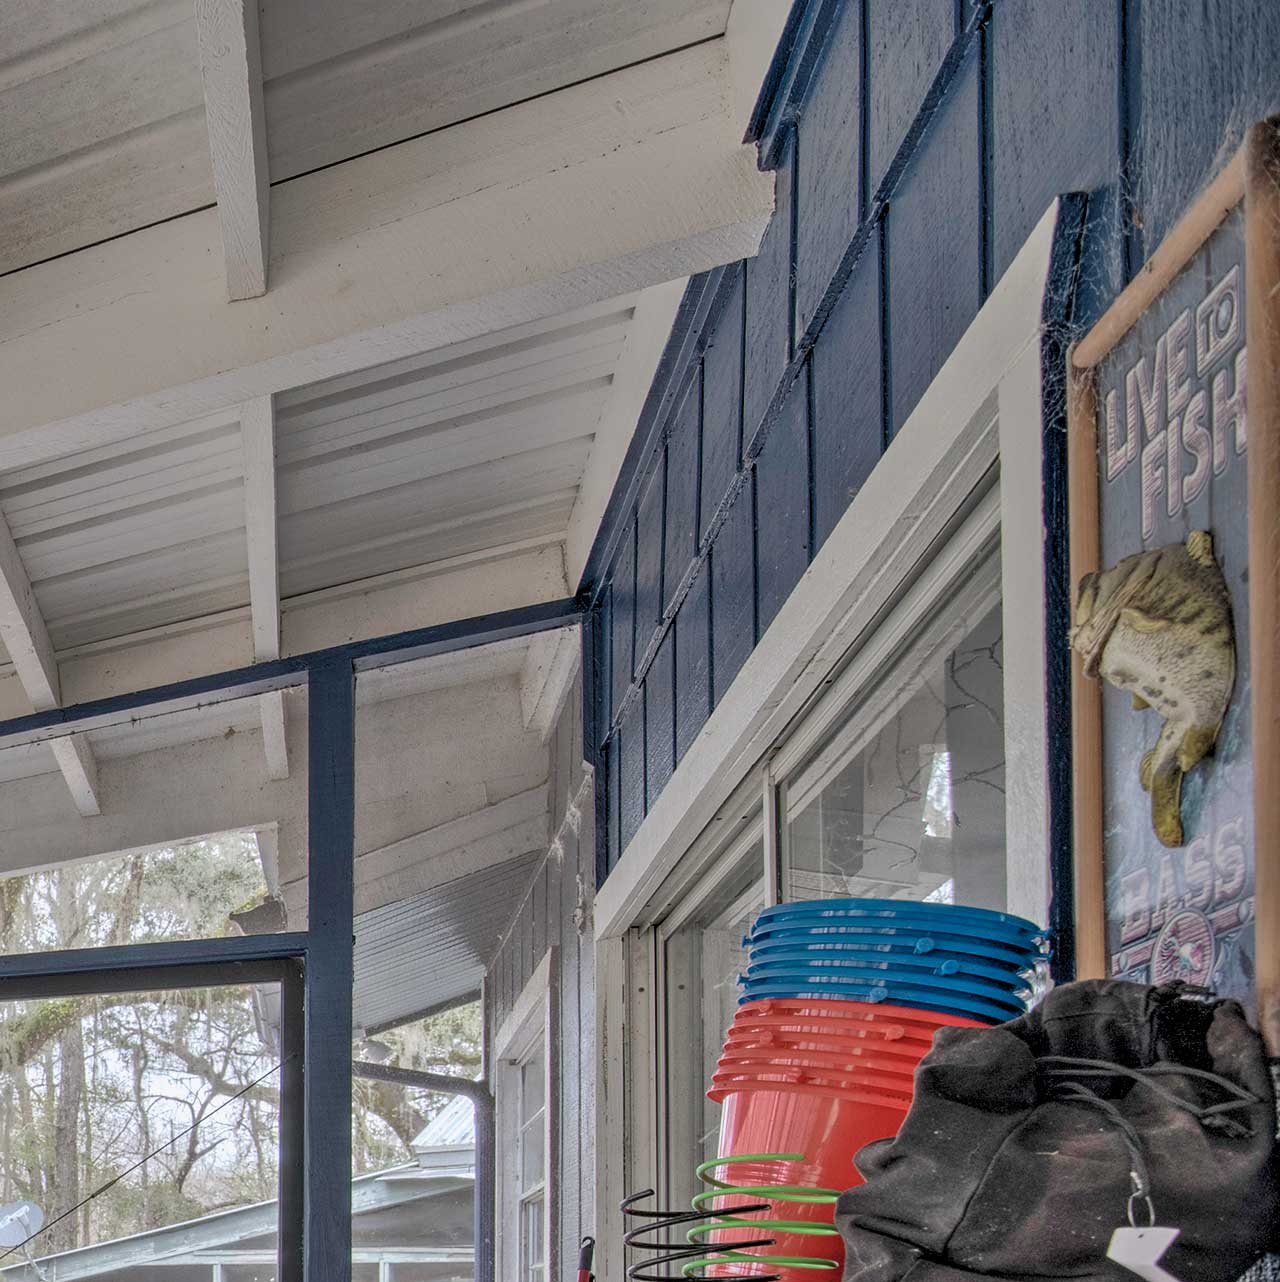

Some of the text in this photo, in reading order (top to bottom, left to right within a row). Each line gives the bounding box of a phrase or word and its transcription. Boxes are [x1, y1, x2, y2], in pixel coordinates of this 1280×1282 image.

[1106, 275, 1238, 483] LIVE TO
[1141, 347, 1247, 540] FISH
[1120, 816, 1247, 946] BASS
